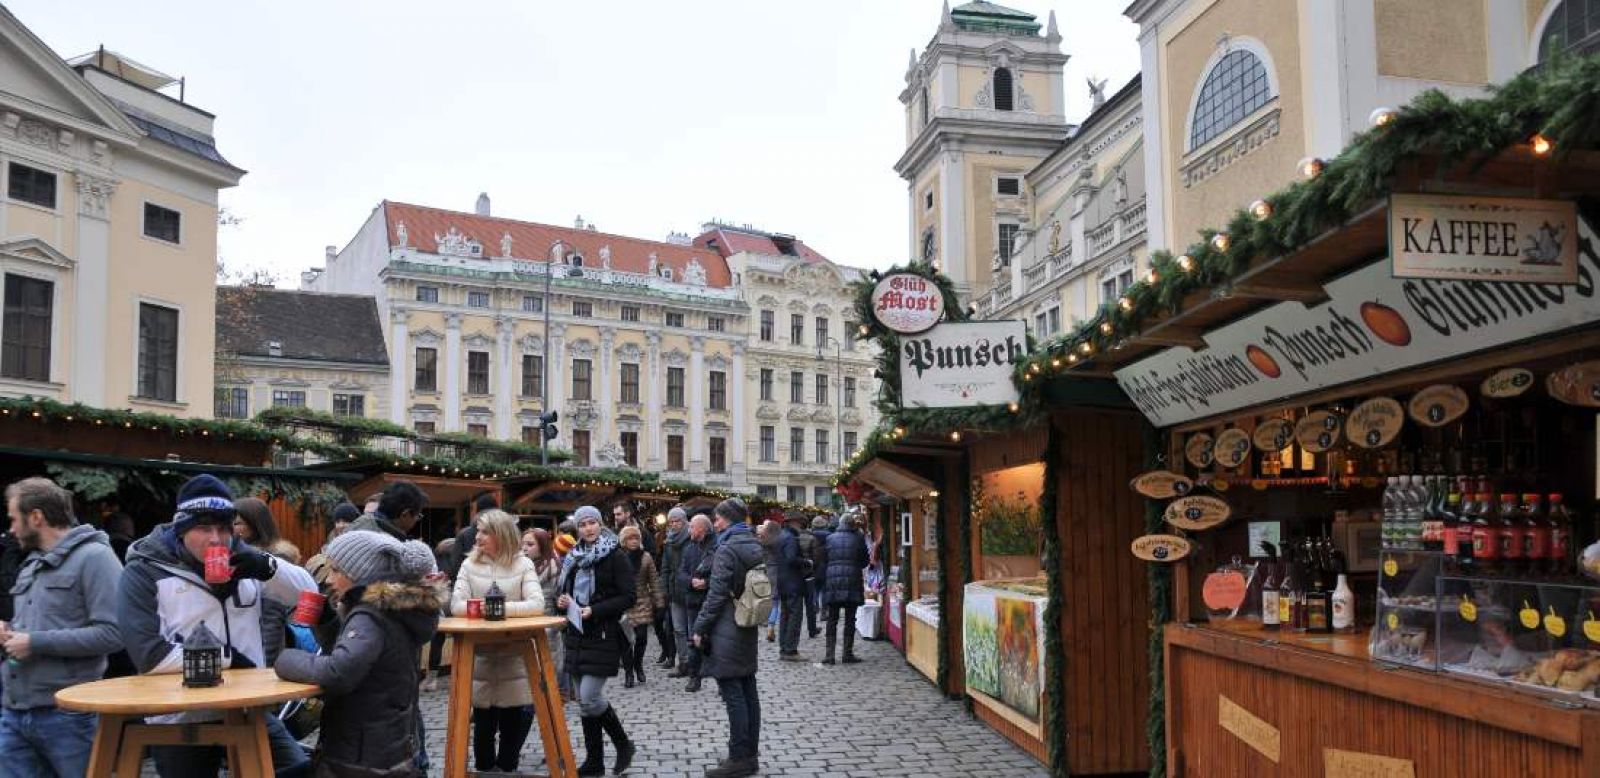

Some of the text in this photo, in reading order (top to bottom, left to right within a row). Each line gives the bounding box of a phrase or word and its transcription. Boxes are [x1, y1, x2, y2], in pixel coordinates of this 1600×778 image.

[1401, 217, 1519, 257] KAFFEE
[876, 291, 938, 312] Most
[889, 276, 926, 295] Glüh
[904, 335, 1022, 380] Punsch
[1263, 306, 1374, 382] Punsch
